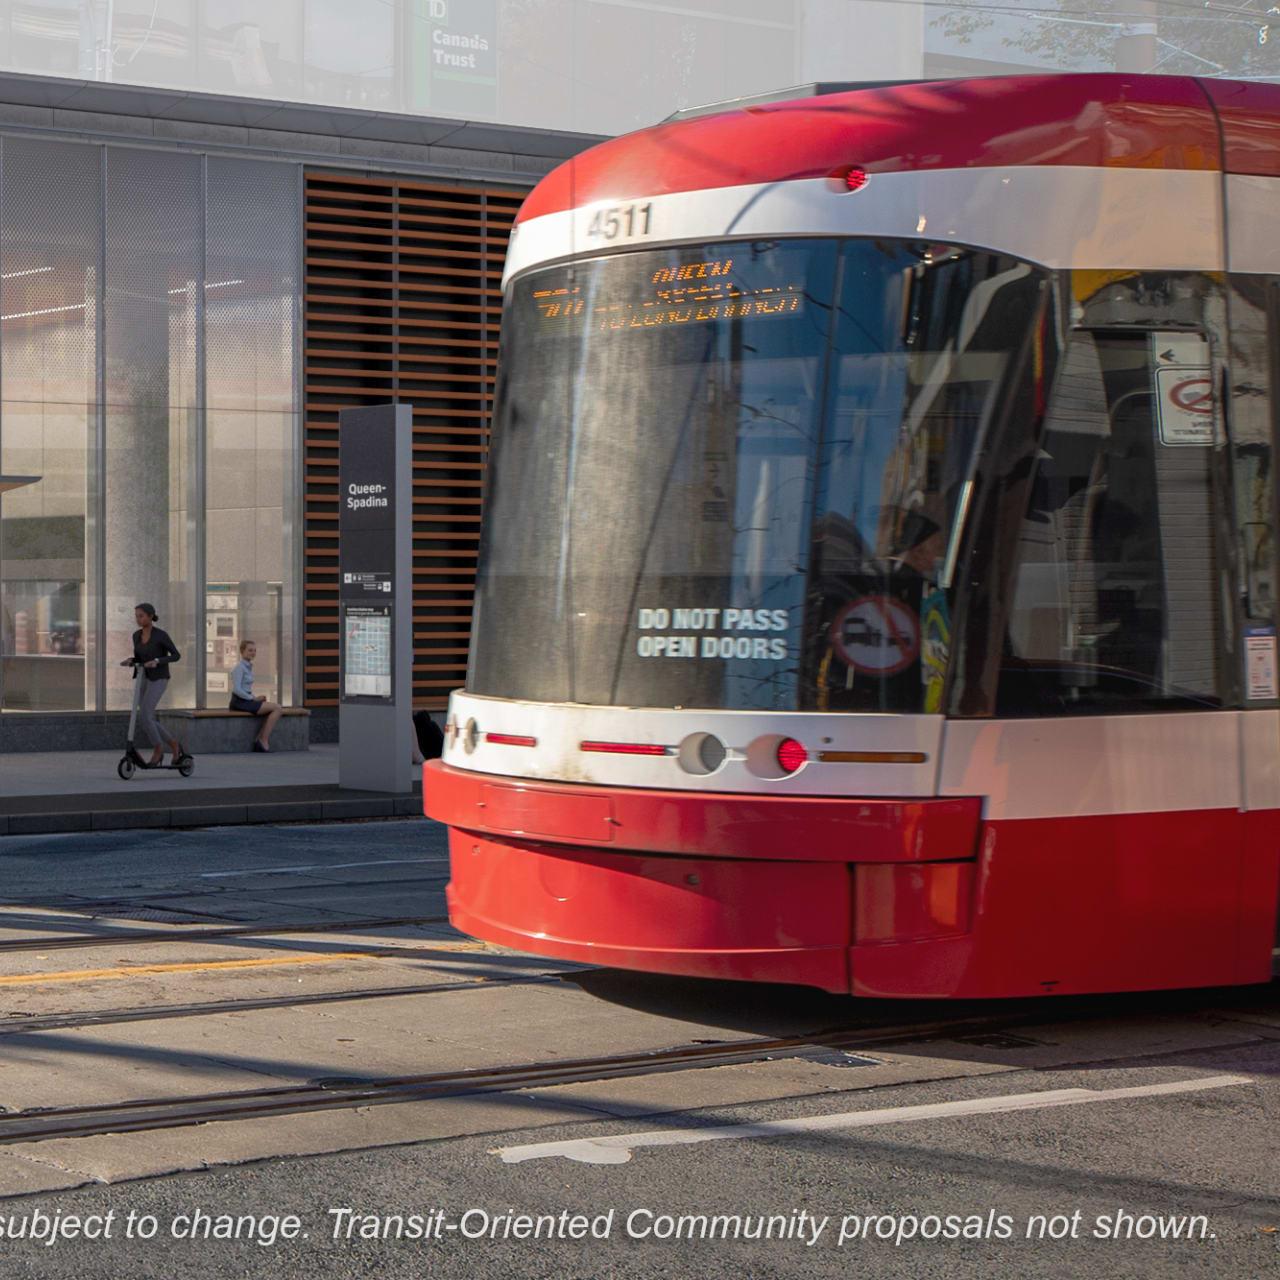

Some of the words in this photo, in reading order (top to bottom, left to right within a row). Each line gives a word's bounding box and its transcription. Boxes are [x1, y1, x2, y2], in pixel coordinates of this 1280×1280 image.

[432, 29, 490, 52] Canada
[432, 48, 477, 69] Trust
[587, 201, 654, 241] 4511
[348, 483, 387, 496] Queen-
[346, 496, 389, 511] Spadina
[638, 607, 670, 630] DO
[672, 607, 721, 630] NOT
[722, 608, 789, 632] PASS
[637, 635, 697, 658] OPEN
[700, 636, 788, 660] DOORS
